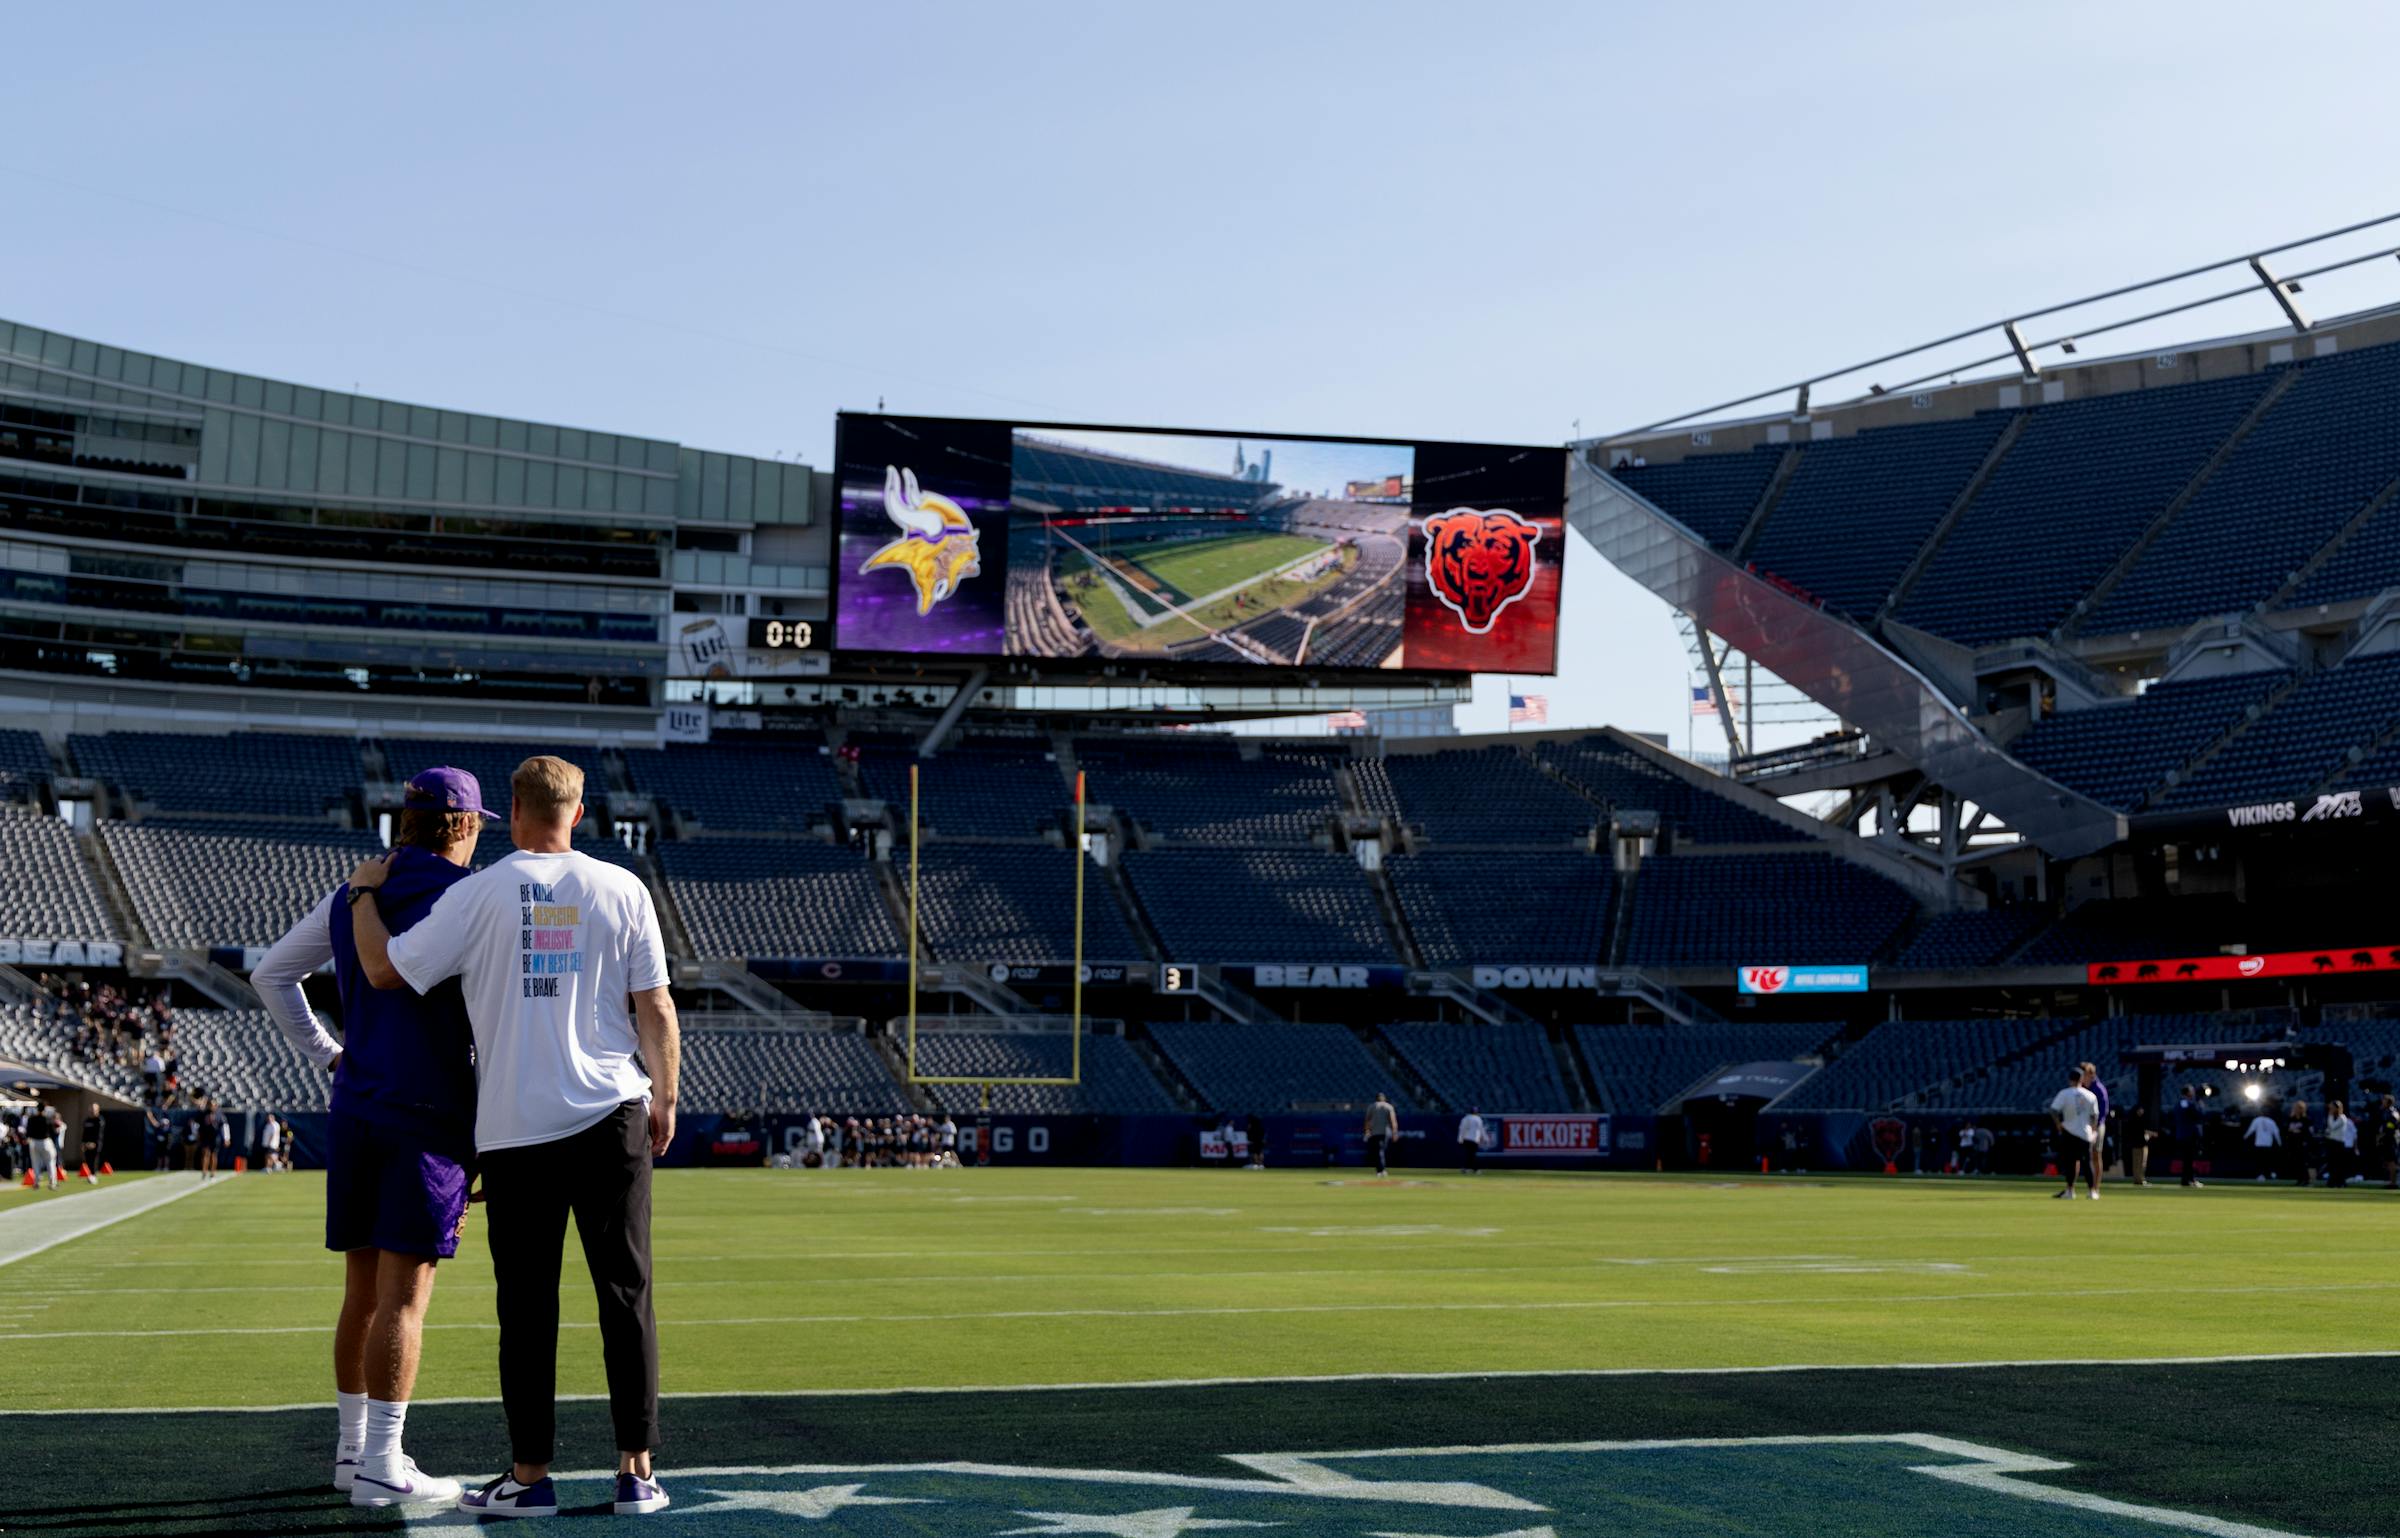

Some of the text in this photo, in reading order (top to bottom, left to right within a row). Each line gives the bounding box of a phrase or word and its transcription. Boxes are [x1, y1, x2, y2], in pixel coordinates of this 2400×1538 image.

[690, 633, 726, 664] Lite
[669, 710, 702, 731] Lite
[2227, 801, 2296, 827] VIKINGS
[520, 883, 555, 903] BE KIND.
[522, 907, 532, 926] BE
[522, 930, 532, 949] BE
[522, 953, 532, 973] BE
[532, 953, 545, 973] MY
[548, 953, 568, 973] BEST
[1011, 967, 1040, 979] razr
[1094, 967, 1122, 980] razr
[1166, 967, 1182, 991] 3
[1254, 965, 1369, 988] BEAR
[1473, 966, 1596, 988] DOWN
[1750, 967, 1784, 991] RC
[523, 977, 560, 997] BE BRAVE.
[1508, 1122, 1593, 1147] KICKOFF
